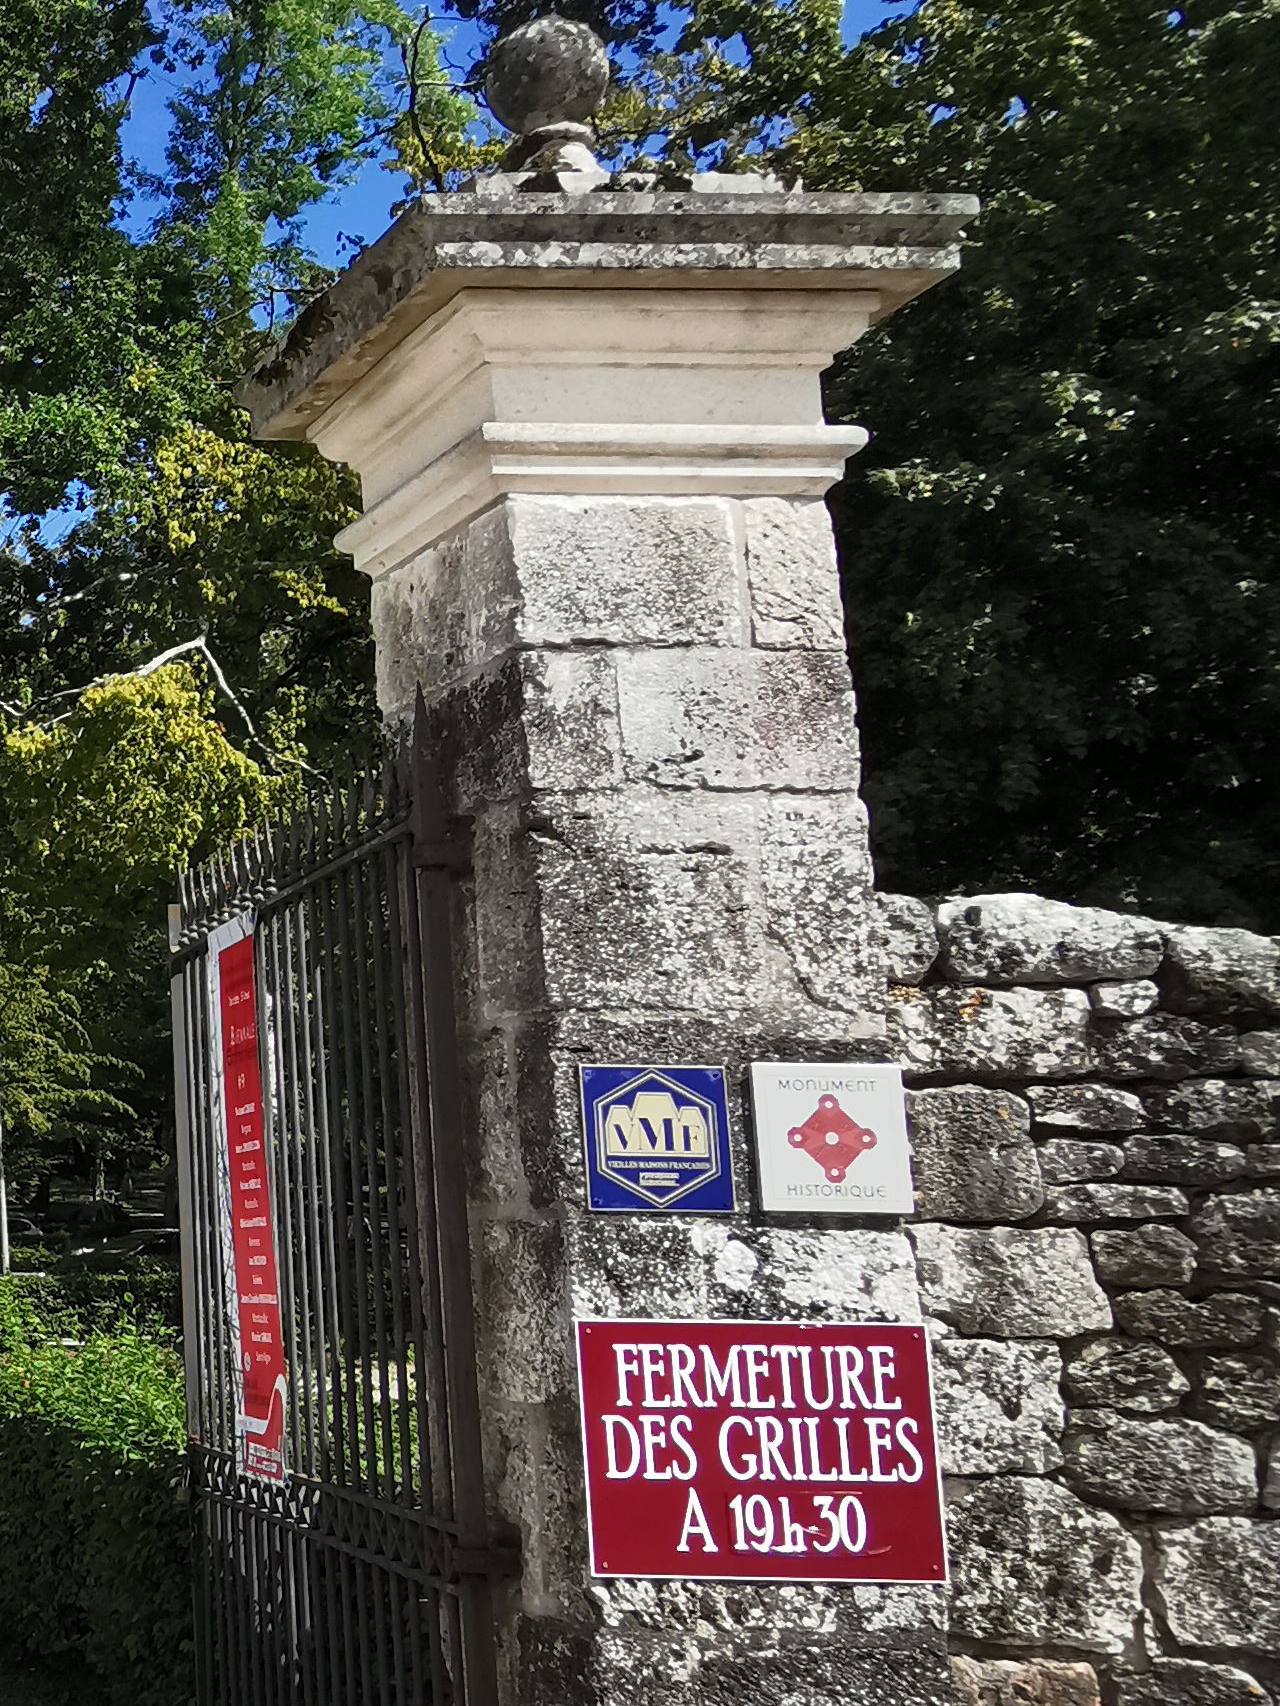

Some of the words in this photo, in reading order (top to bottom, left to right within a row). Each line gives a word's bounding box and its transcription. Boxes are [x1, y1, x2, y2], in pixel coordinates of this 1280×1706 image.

[778, 1079, 878, 1093] MONUMENT
[613, 1117, 701, 1152] VMF
[786, 1184, 888, 1198] HISTORIQUE
[611, 1342, 903, 1411] FERMETURE
[600, 1414, 699, 1482] DES
[718, 1415, 925, 1484] GRILLES
[675, 1486, 719, 1553] A
